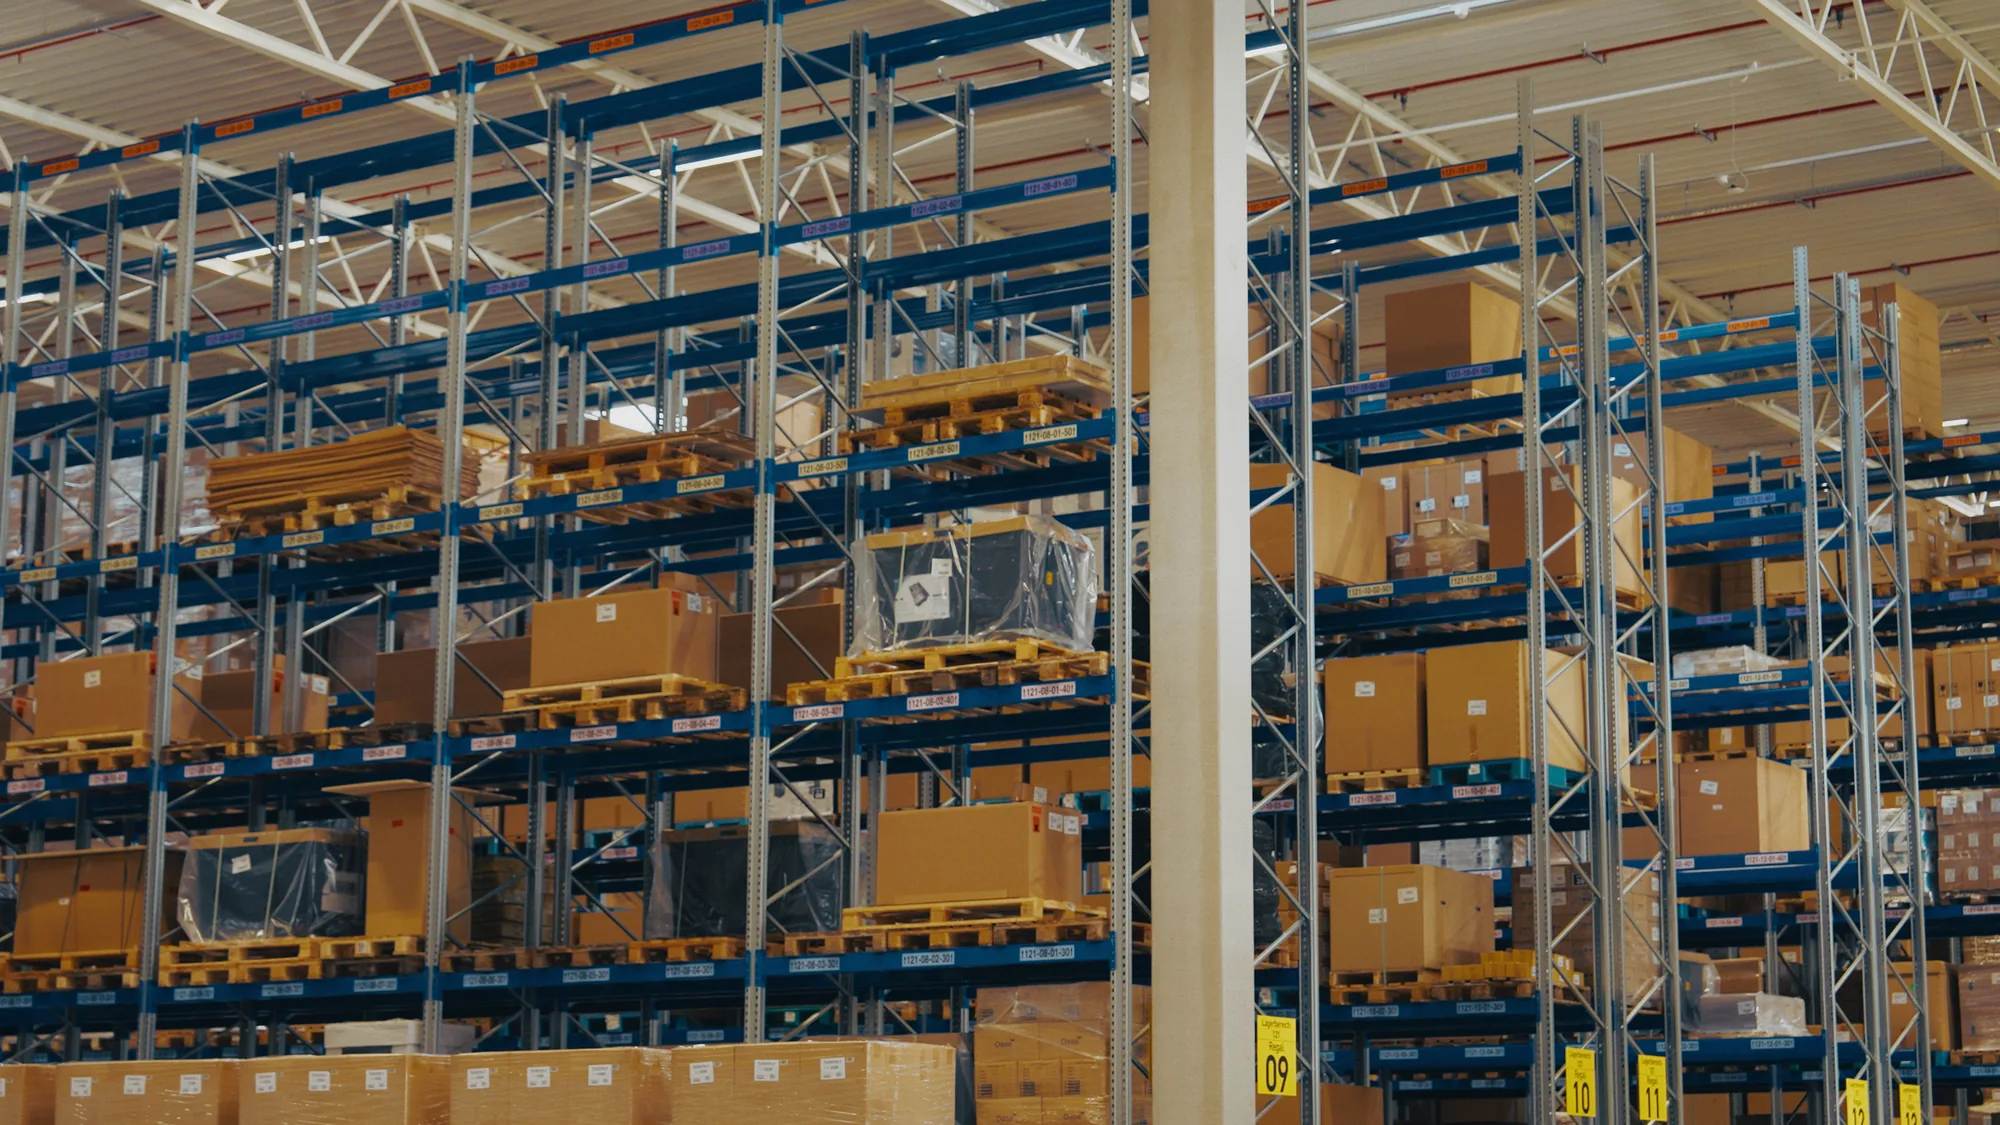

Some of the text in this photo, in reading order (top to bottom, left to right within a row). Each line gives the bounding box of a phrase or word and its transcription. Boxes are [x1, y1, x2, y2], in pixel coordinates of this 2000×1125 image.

[1266, 1054, 1288, 1093] 09
[1573, 1081, 1590, 1114] 10
[1645, 1087, 1660, 1119] 11
